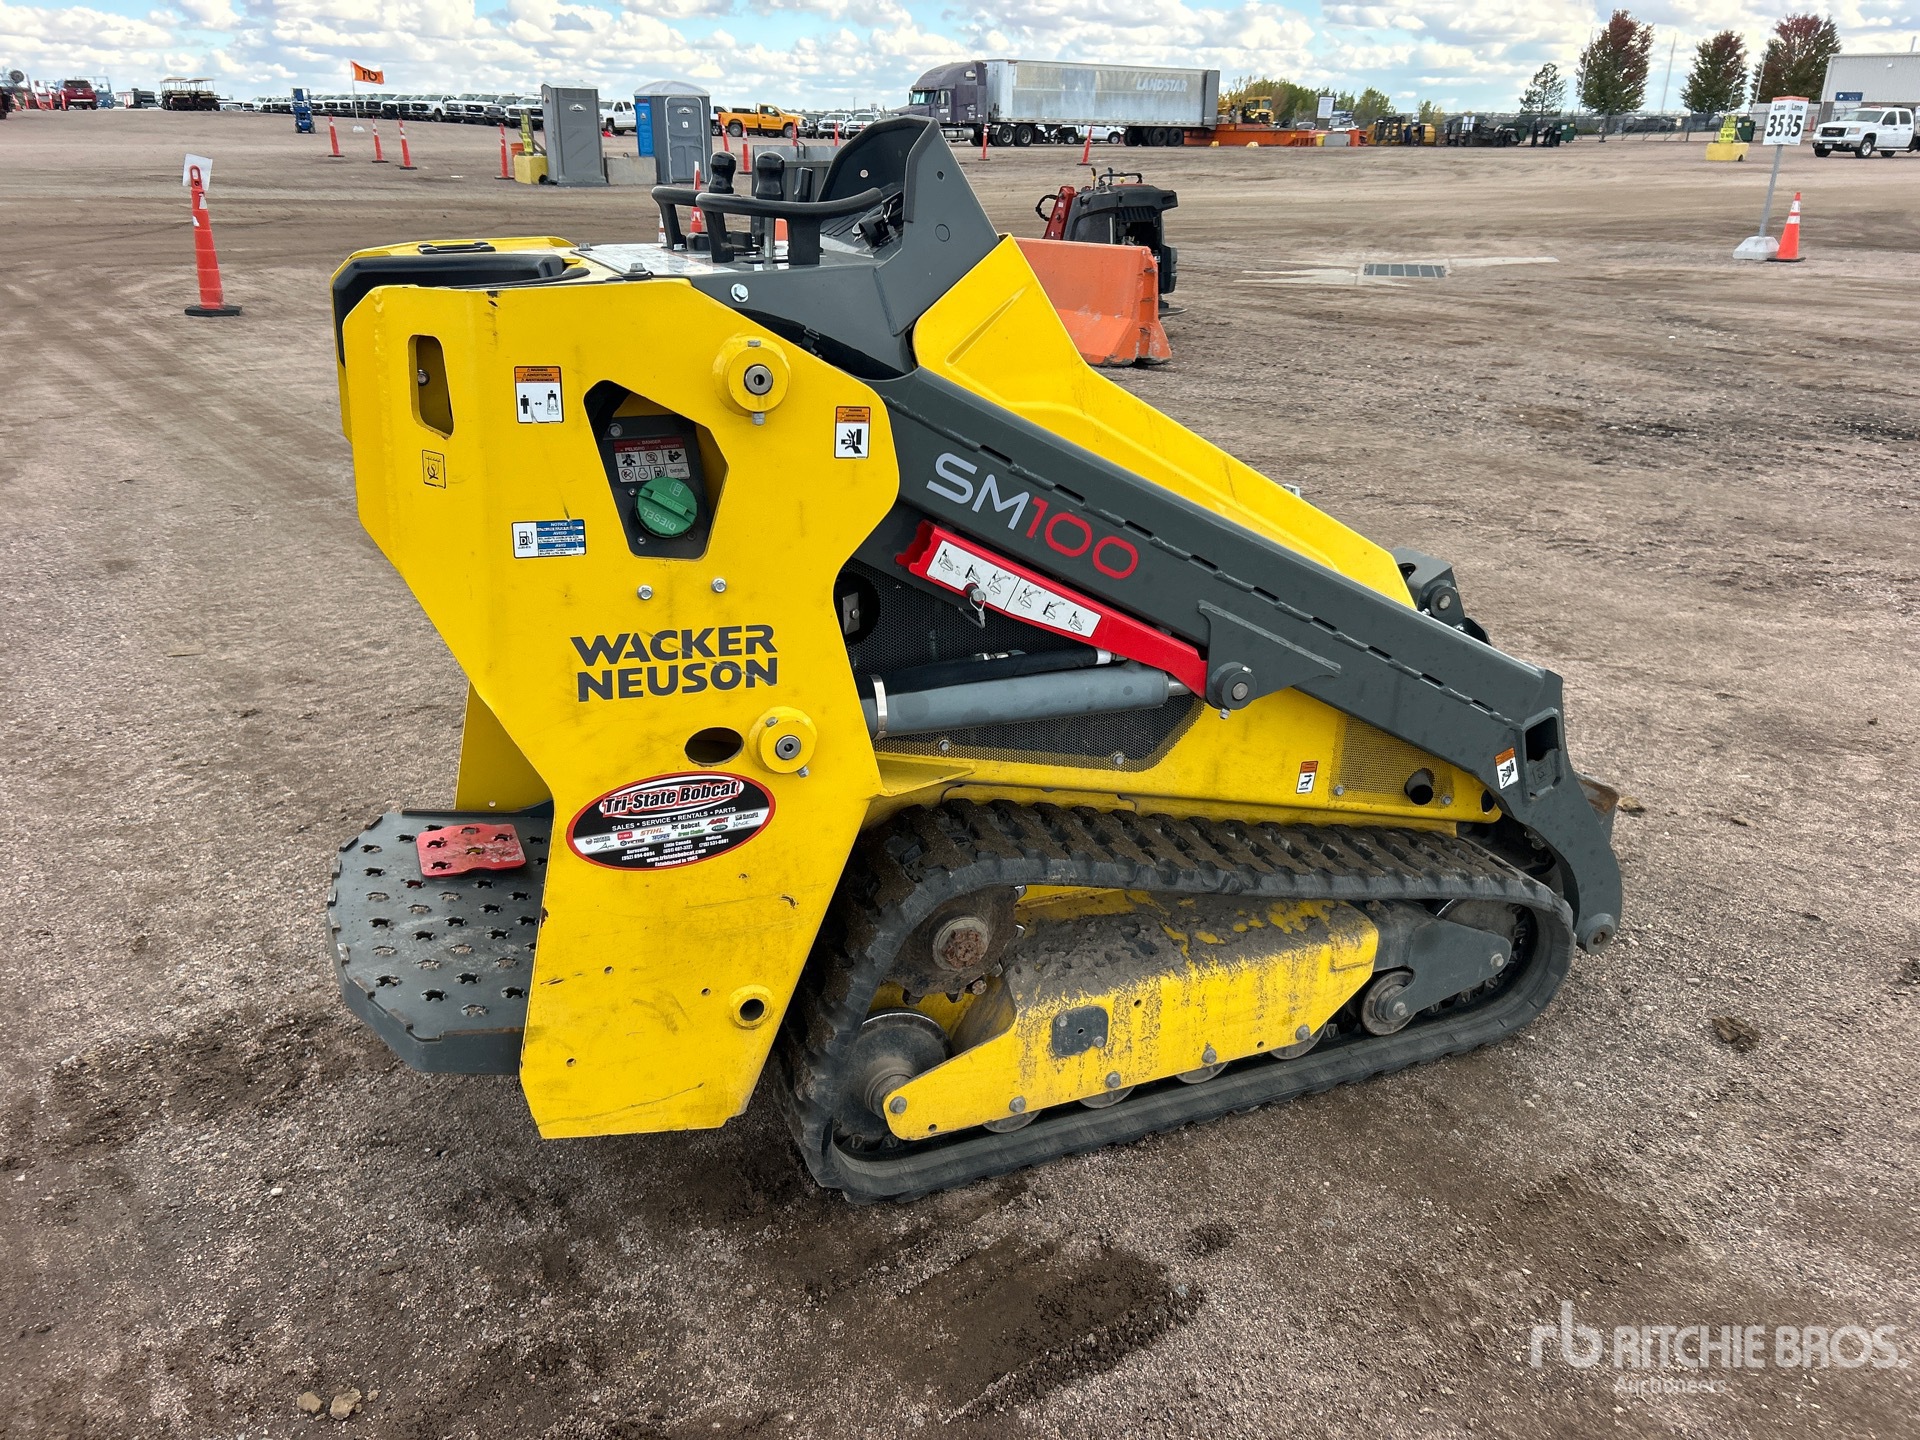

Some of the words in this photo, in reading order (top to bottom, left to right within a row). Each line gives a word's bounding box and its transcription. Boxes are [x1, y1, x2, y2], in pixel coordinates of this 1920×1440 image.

[1136, 79, 1188, 92] LANDSTAR
[1774, 103, 1786, 111] Lane
[1791, 103, 1803, 111] Lane
[1766, 114, 1785, 137] 35
[1784, 114, 1803, 137] 35
[643, 507, 677, 531] DIESEL
[926, 452, 1139, 580] SM100
[570, 624, 778, 667] WACKER
[577, 657, 778, 702] NEUSON
[604, 793, 676, 814] Tri-State
[679, 780, 738, 802] Bobcat
[611, 822, 635, 832] SALES
[641, 817, 671, 827] SERVICE
[677, 811, 709, 821] RENTALS
[714, 806, 737, 816] PARTS
[680, 821, 700, 830] Bobcat
[640, 828, 664, 836] STIHL
